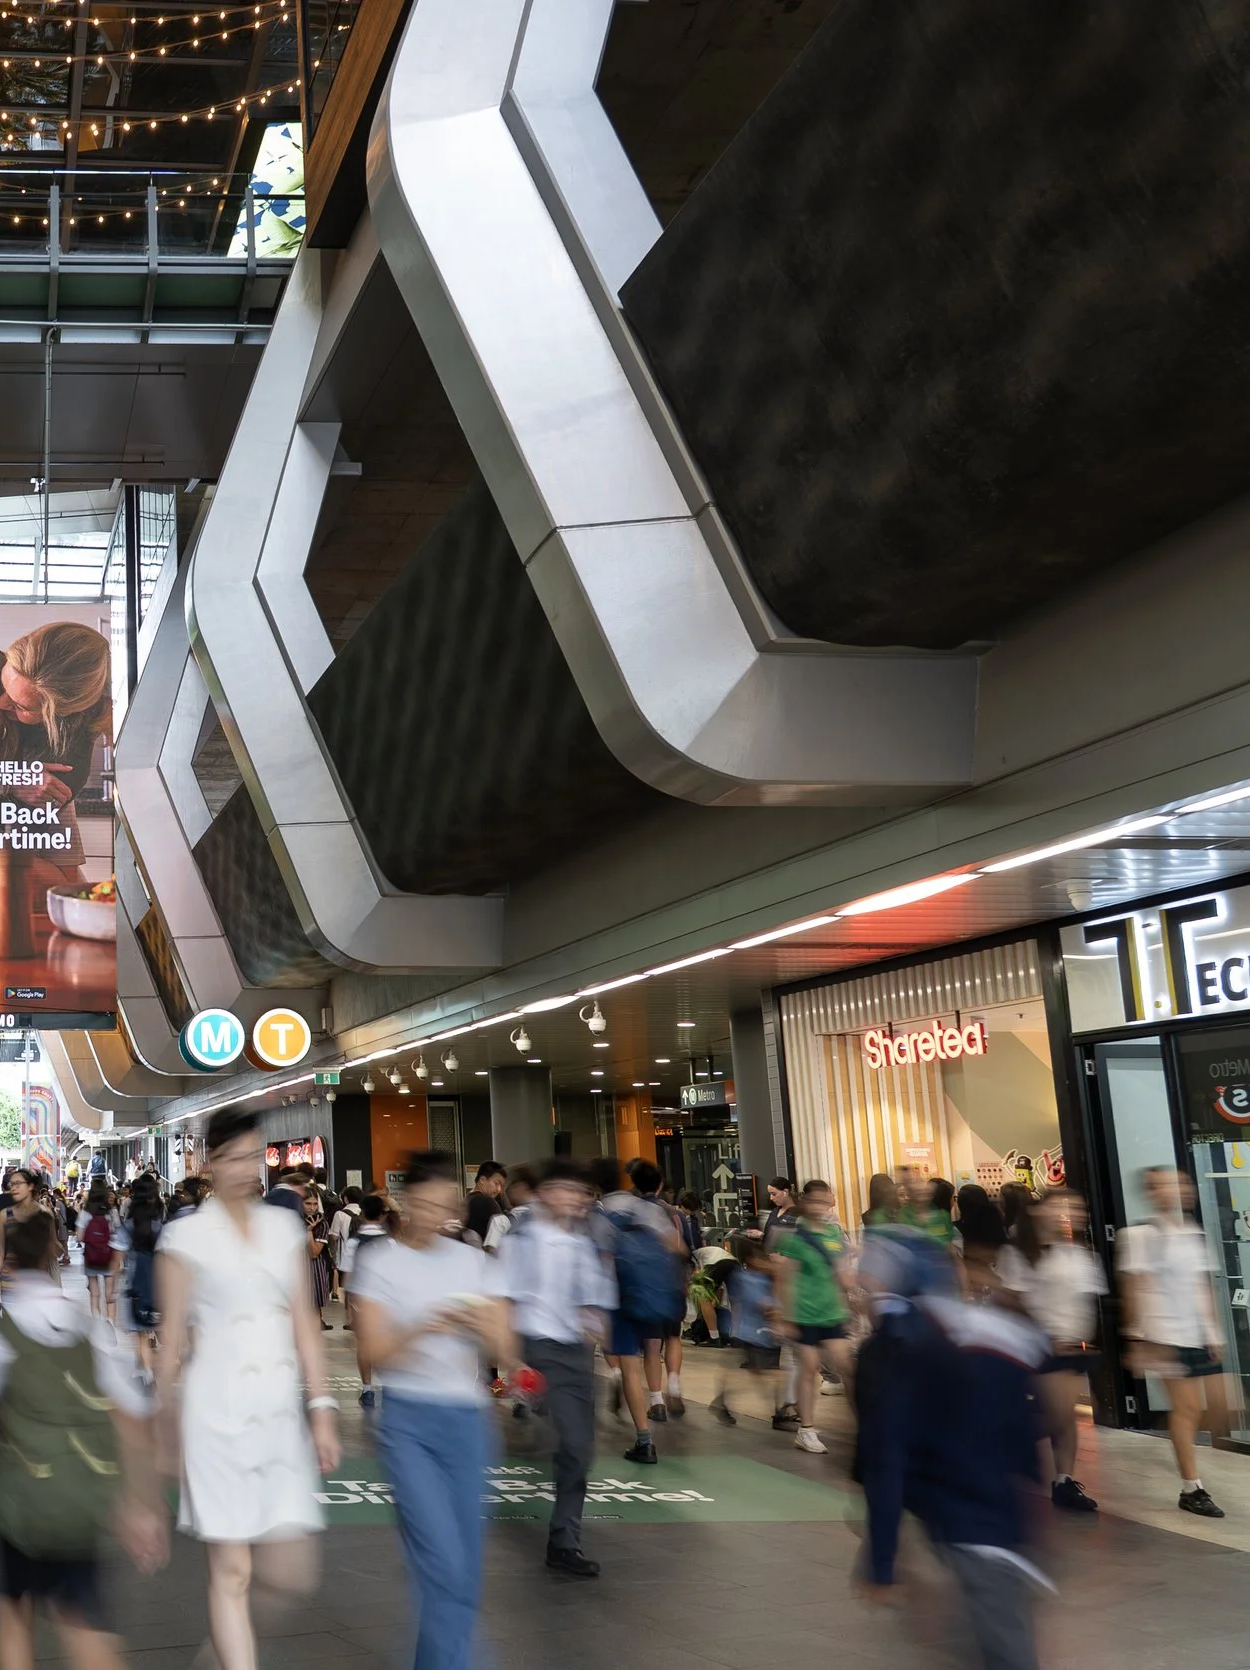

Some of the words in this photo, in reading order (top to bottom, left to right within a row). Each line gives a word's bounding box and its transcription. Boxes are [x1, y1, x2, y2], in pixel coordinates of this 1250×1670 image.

[0, 801, 60, 825] Back
[200, 1021, 232, 1053] M
[269, 1023, 295, 1055] T
[865, 1020, 987, 1070] Sharetea
[697, 1089, 716, 1102] Metro
